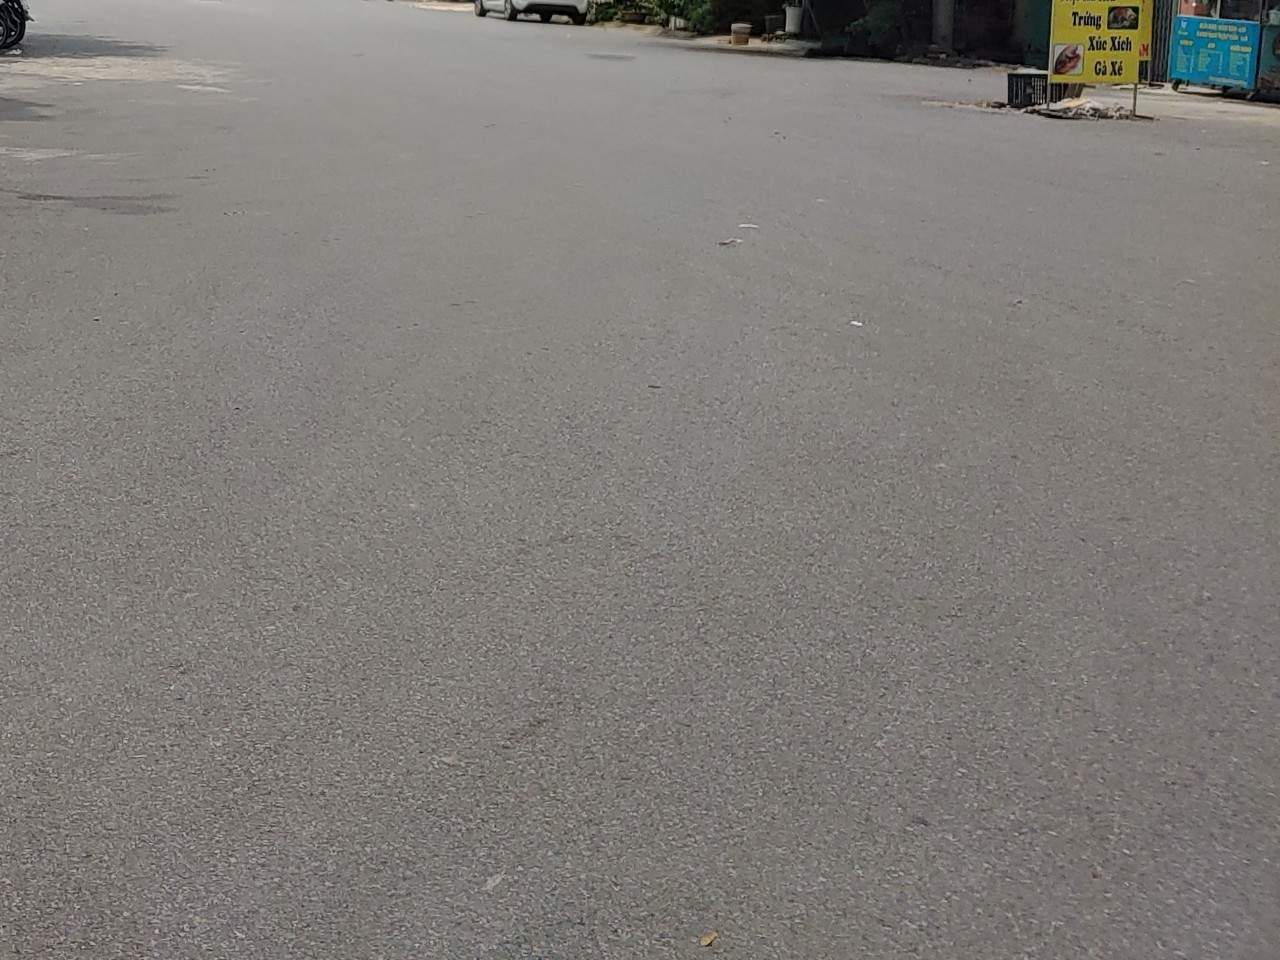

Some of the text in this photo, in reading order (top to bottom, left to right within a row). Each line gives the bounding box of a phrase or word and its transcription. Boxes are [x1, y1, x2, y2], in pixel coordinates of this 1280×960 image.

[1072, 11, 1102, 30] Trứng
[1087, 35, 1132, 52] Xúc Xích
